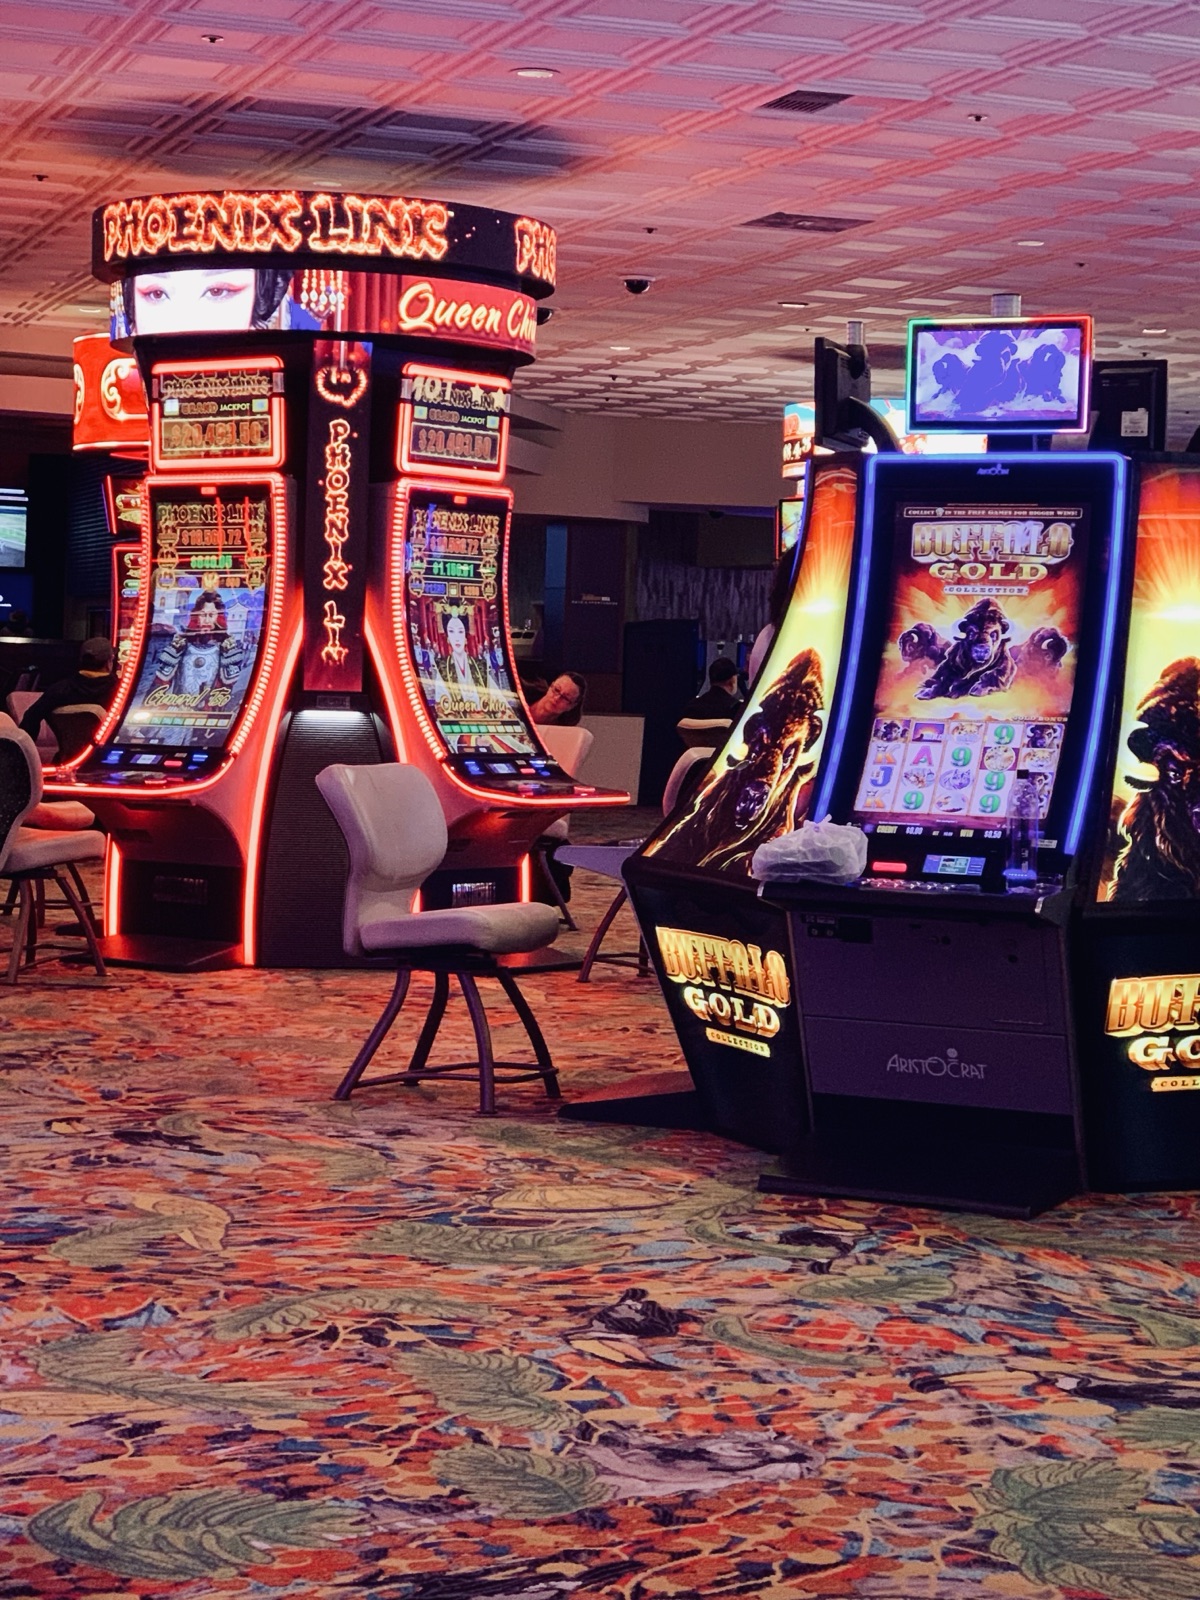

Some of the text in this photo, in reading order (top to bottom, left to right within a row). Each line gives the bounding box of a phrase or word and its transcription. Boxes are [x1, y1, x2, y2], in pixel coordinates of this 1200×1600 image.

[103, 192, 449, 262] PHOENIX LINK
[398, 281, 501, 334] Queen
[181, 401, 250, 414] GRAND JACKPOT
[460, 415, 486, 425] JACKPOT
[157, 504, 226, 524] PHOENIX
[324, 418, 351, 590] PHOENIX
[912, 521, 1074, 562] BUFFALO
[928, 562, 1048, 582] GOLD
[946, 586, 1027, 595] COLLECTION
[440, 694, 478, 715] Queen
[877, 825, 898, 834] CREDIT
[960, 829, 974, 837] WIN
[984, 830, 1002, 839] $0.50
[655, 926, 791, 1008] BUFFALO
[684, 986, 781, 1038] GOLD
[708, 1029, 768, 1054] COLLECTION
[886, 1050, 988, 1080] ARISTOCRAT
